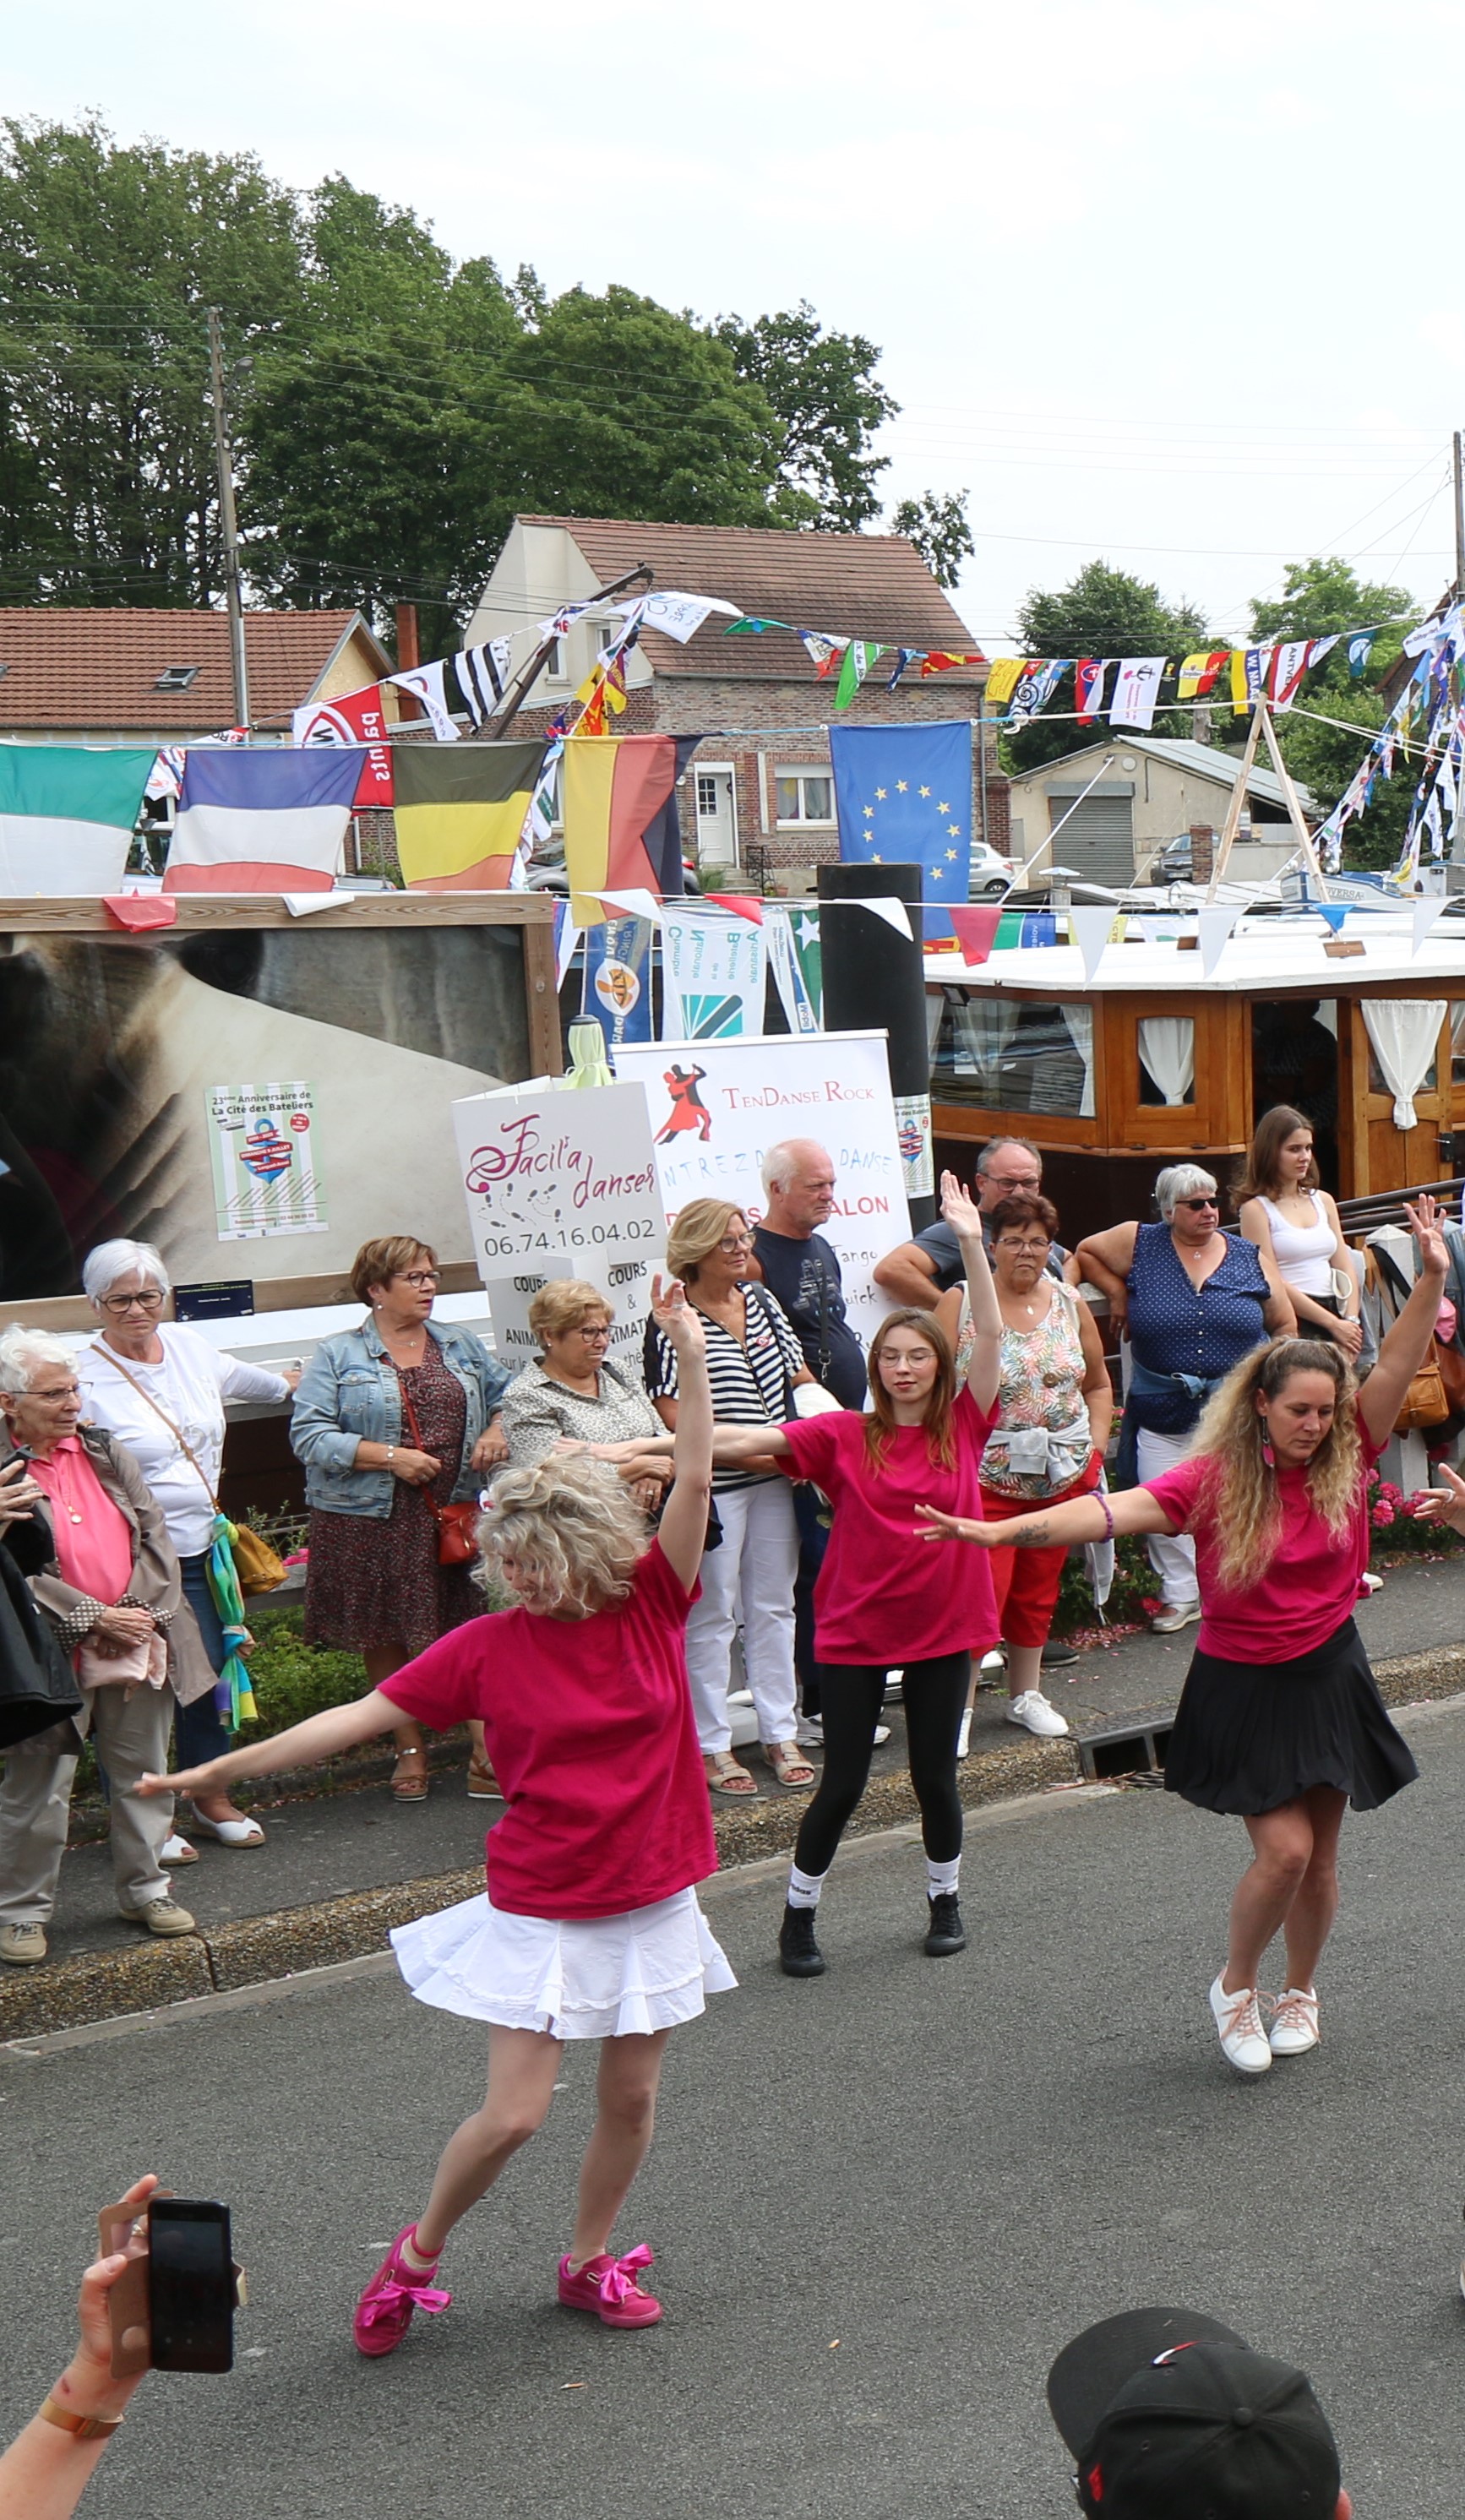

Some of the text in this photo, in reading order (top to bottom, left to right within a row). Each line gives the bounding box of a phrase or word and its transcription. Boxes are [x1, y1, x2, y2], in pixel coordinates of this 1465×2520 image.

[211, 1101, 313, 1116] La Cité des Bateliers
[237, 1091, 297, 1103] Anniversaire
[299, 1091, 311, 1099] de
[663, 1152, 749, 1188] NTREZ
[839, 1148, 893, 1175] DANSE
[573, 1155, 656, 1209] danser
[829, 1195, 890, 1216] ALON
[484, 1219, 656, 1256] 06.74.16.04.02
[607, 1260, 648, 1287] COURS
[627, 1293, 637, 1309] &
[846, 1285, 878, 1305] uick
